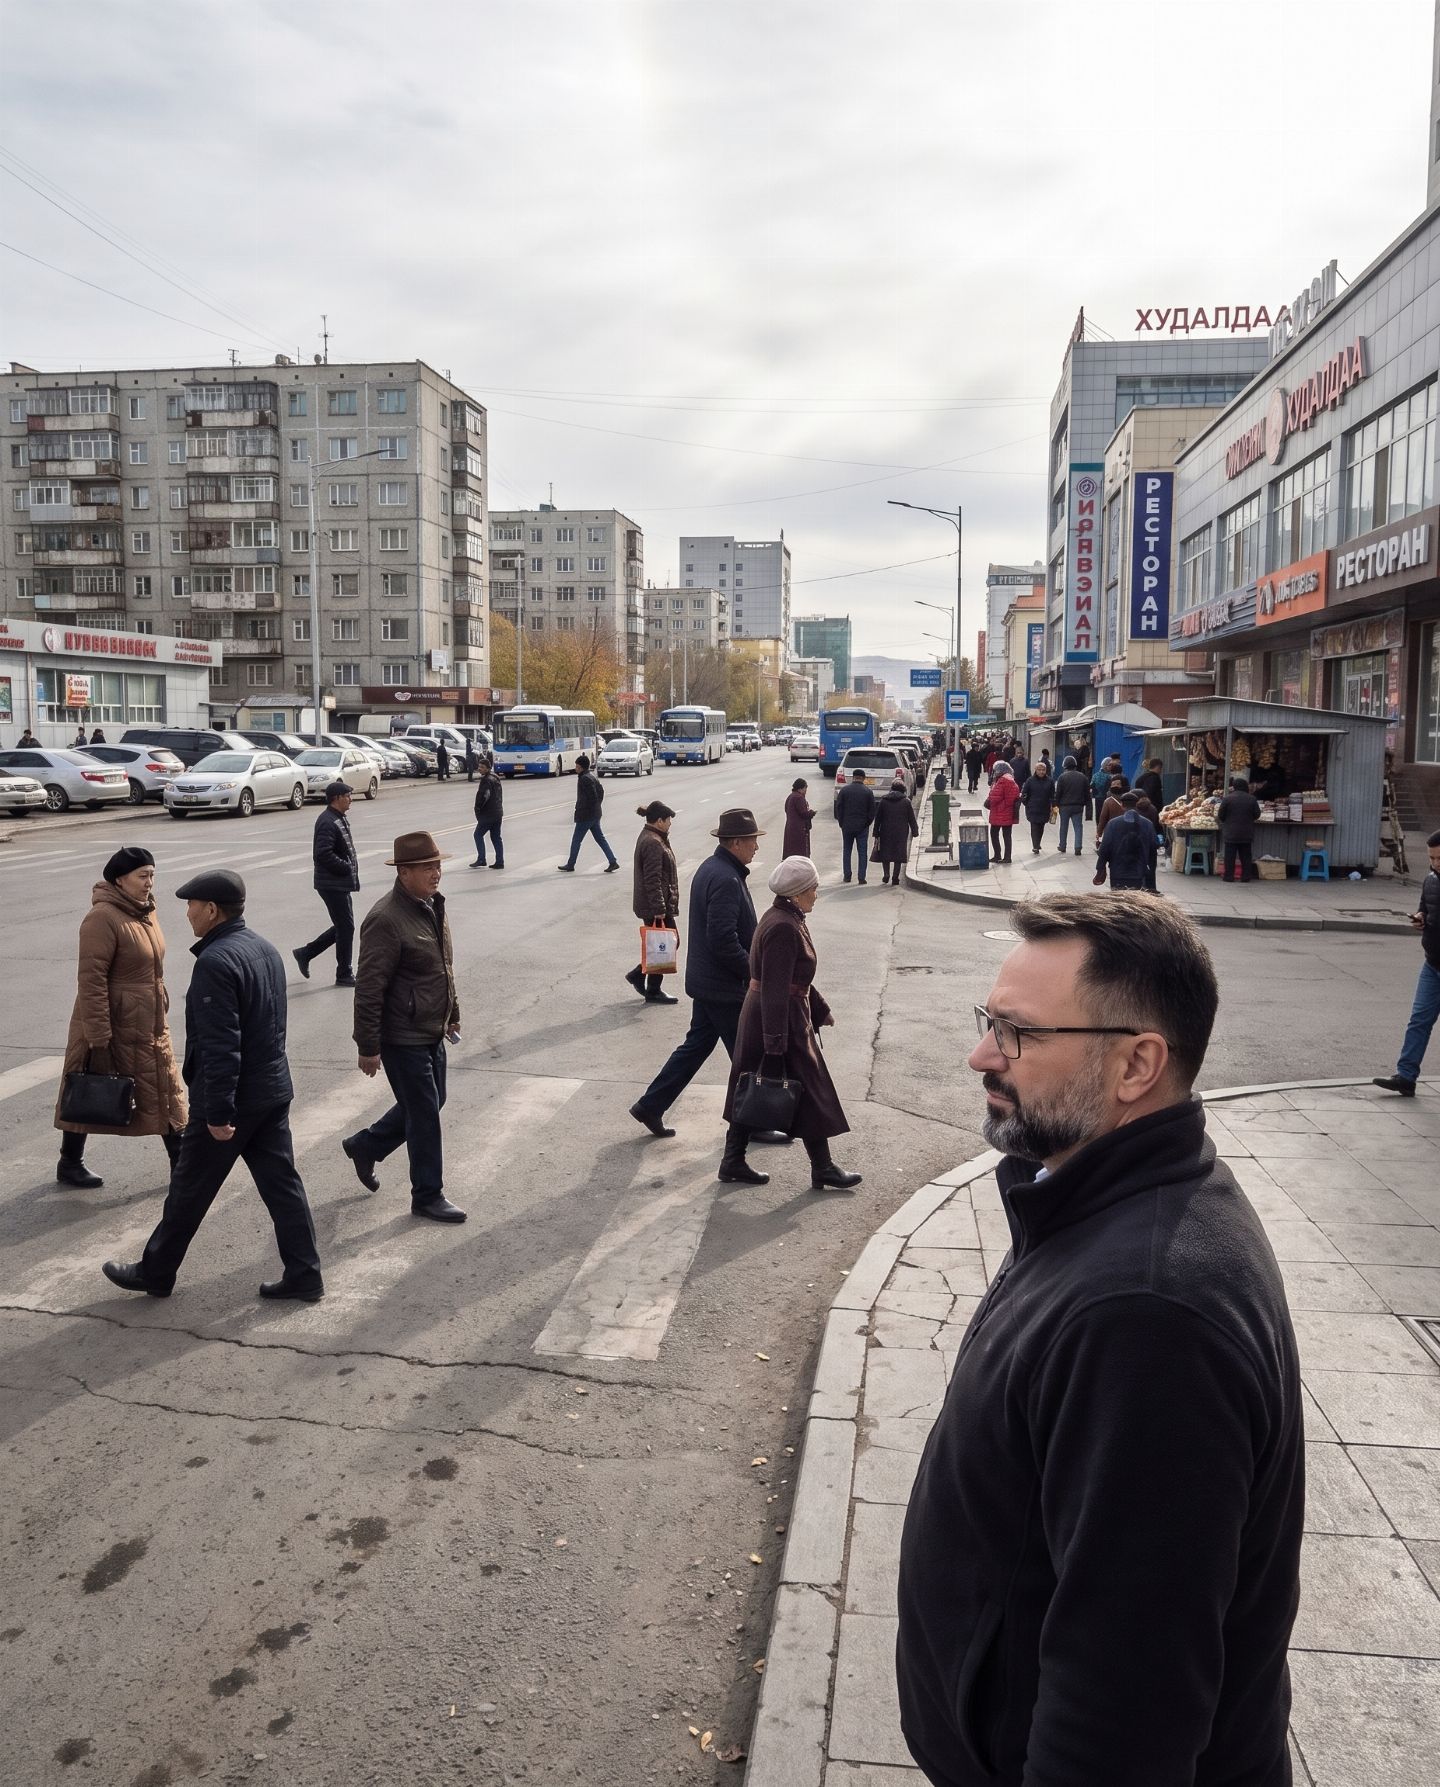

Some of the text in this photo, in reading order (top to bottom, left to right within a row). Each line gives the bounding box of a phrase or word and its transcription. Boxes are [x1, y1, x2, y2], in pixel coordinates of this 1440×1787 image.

[1286, 336, 1365, 431] ХУДАЛДАА
[1141, 478, 1161, 631] РЕСТОРАН
[1336, 524, 1429, 589] РЕСТОРАН
